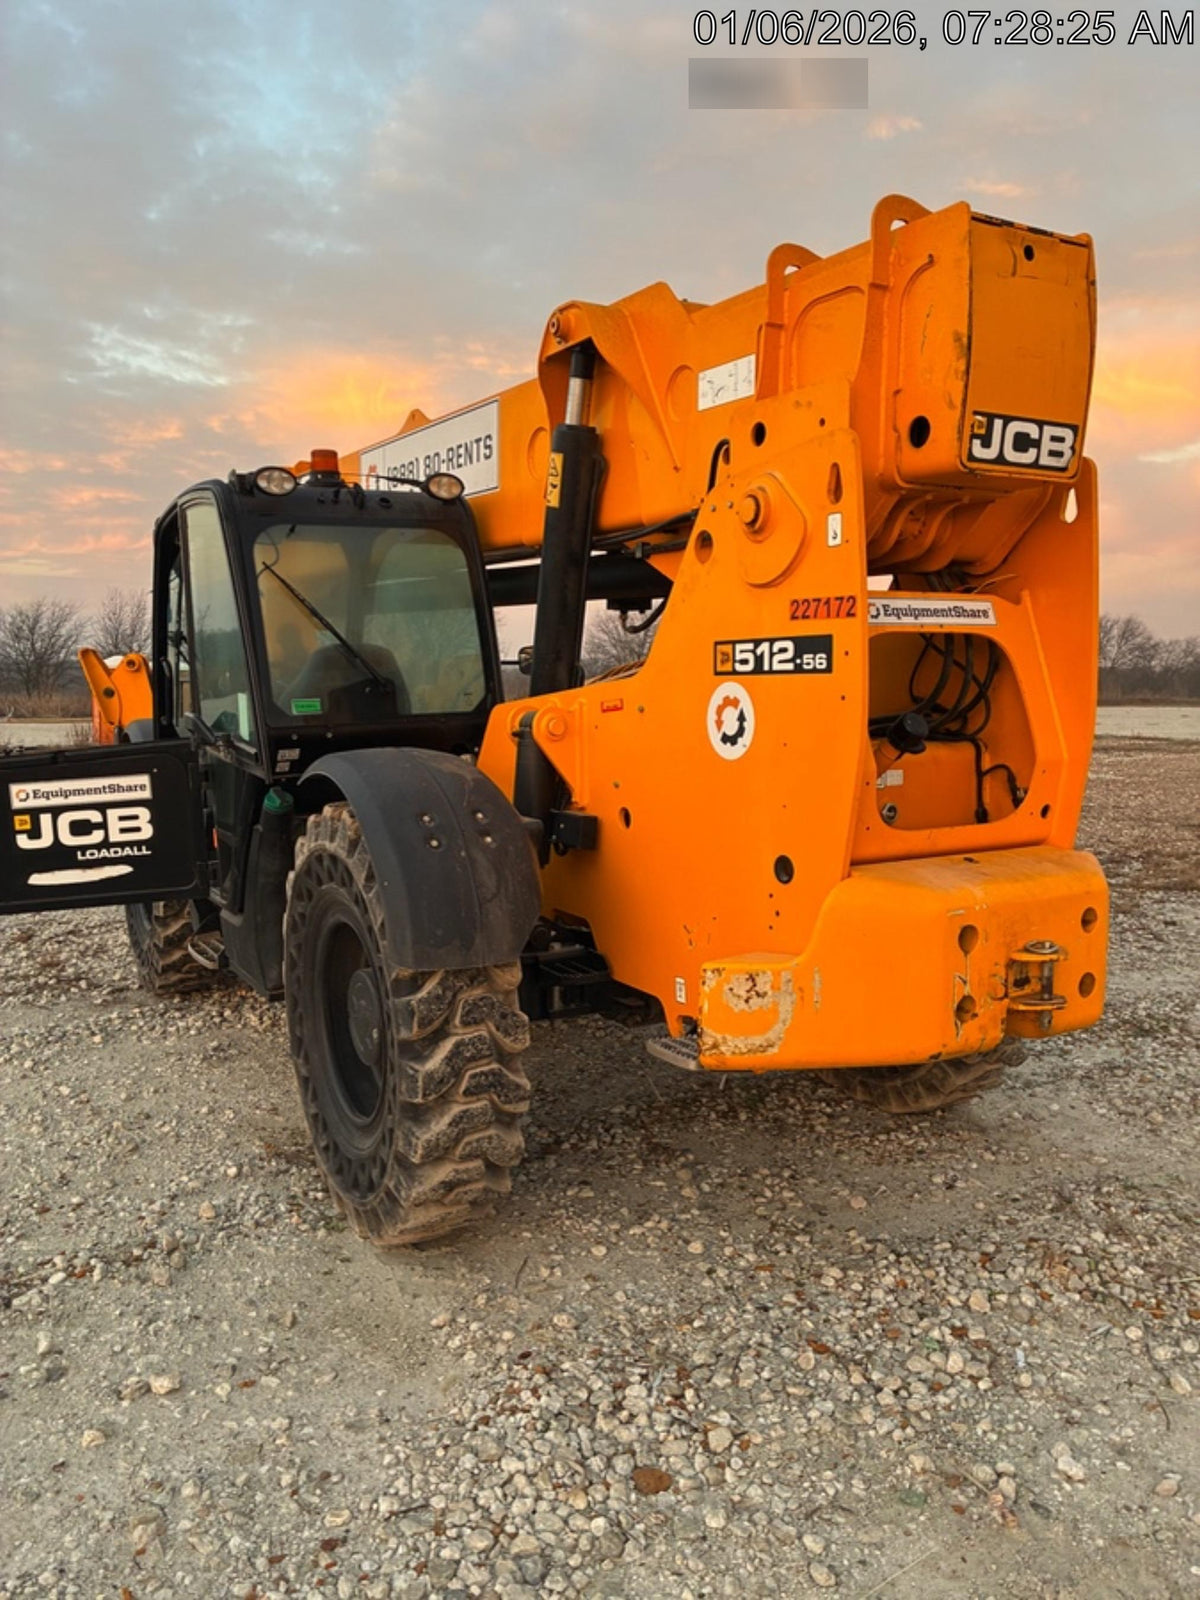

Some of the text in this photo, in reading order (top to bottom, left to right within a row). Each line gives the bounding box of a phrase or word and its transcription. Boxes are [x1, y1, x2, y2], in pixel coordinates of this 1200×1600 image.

[971, 418, 1075, 468] JCB
[790, 596, 856, 620] 227172
[882, 603, 989, 620] EquipmentShare
[32, 784, 147, 800] EquipmentShare
[15, 806, 154, 850] JCB
[77, 845, 152, 861] LOADALL
